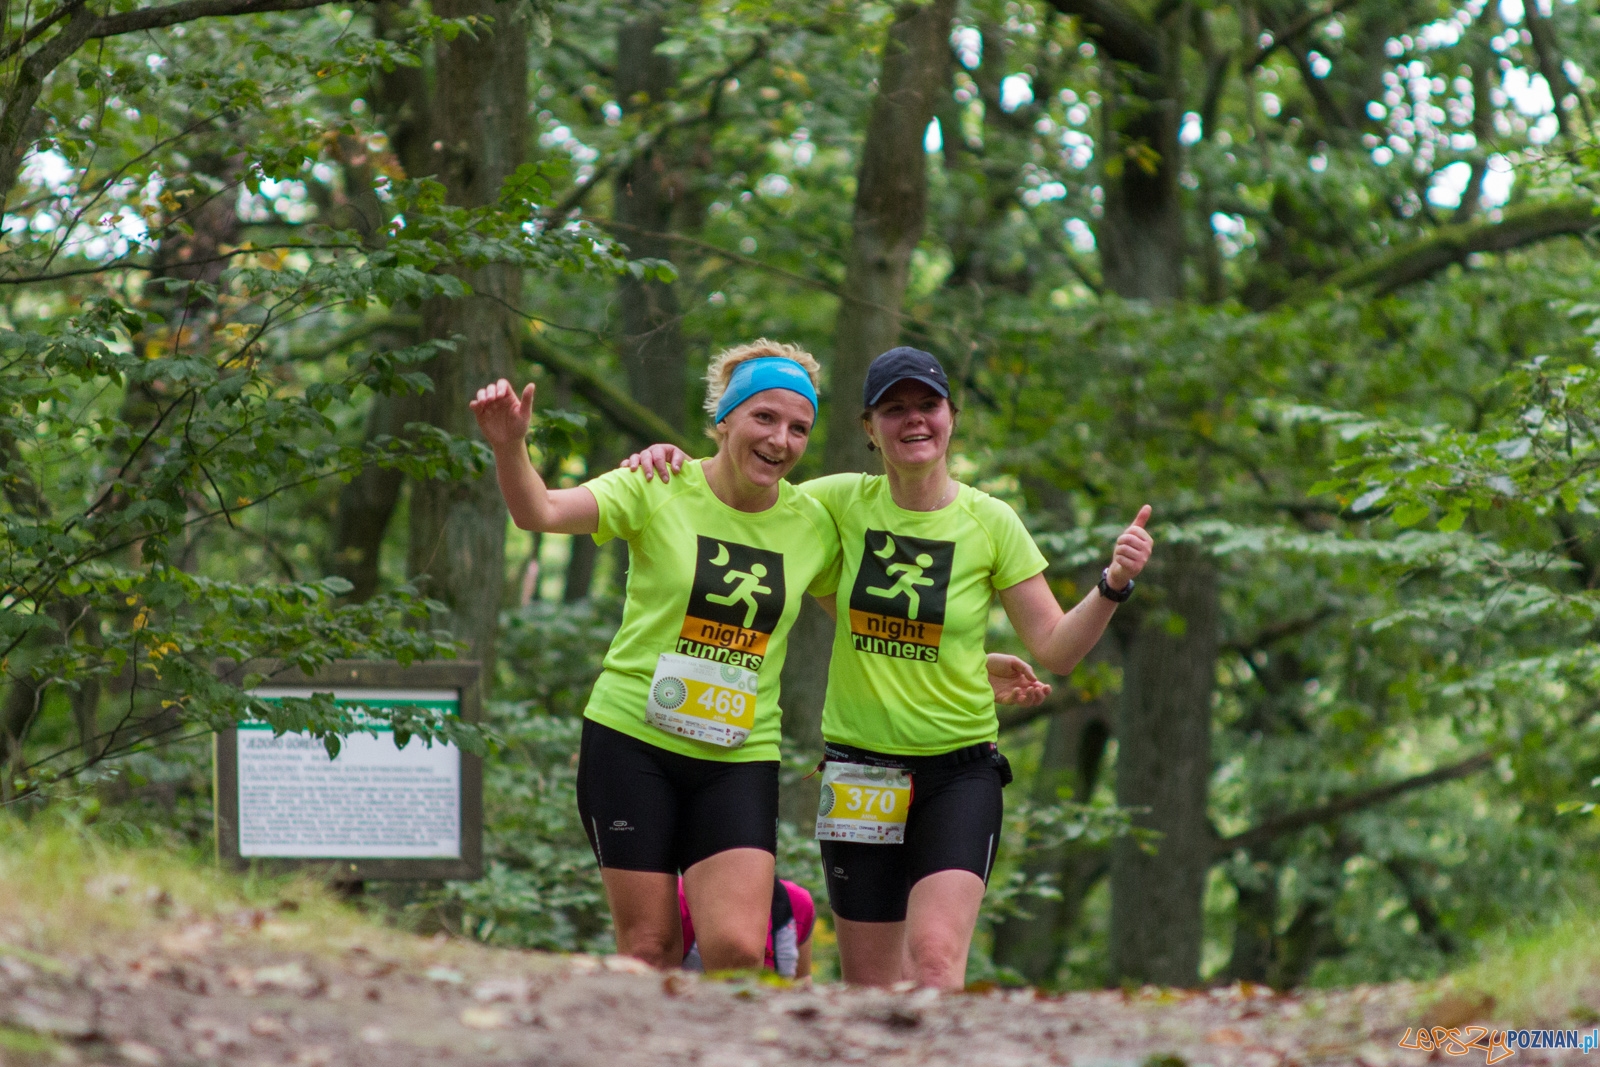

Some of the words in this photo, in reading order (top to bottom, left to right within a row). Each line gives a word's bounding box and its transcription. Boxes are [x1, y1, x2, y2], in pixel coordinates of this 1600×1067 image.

[701, 623, 758, 648] night
[867, 616, 925, 640] night
[676, 638, 763, 670] runners
[852, 634, 938, 662] runners
[697, 687, 746, 718] 469
[846, 788, 896, 814] 370
